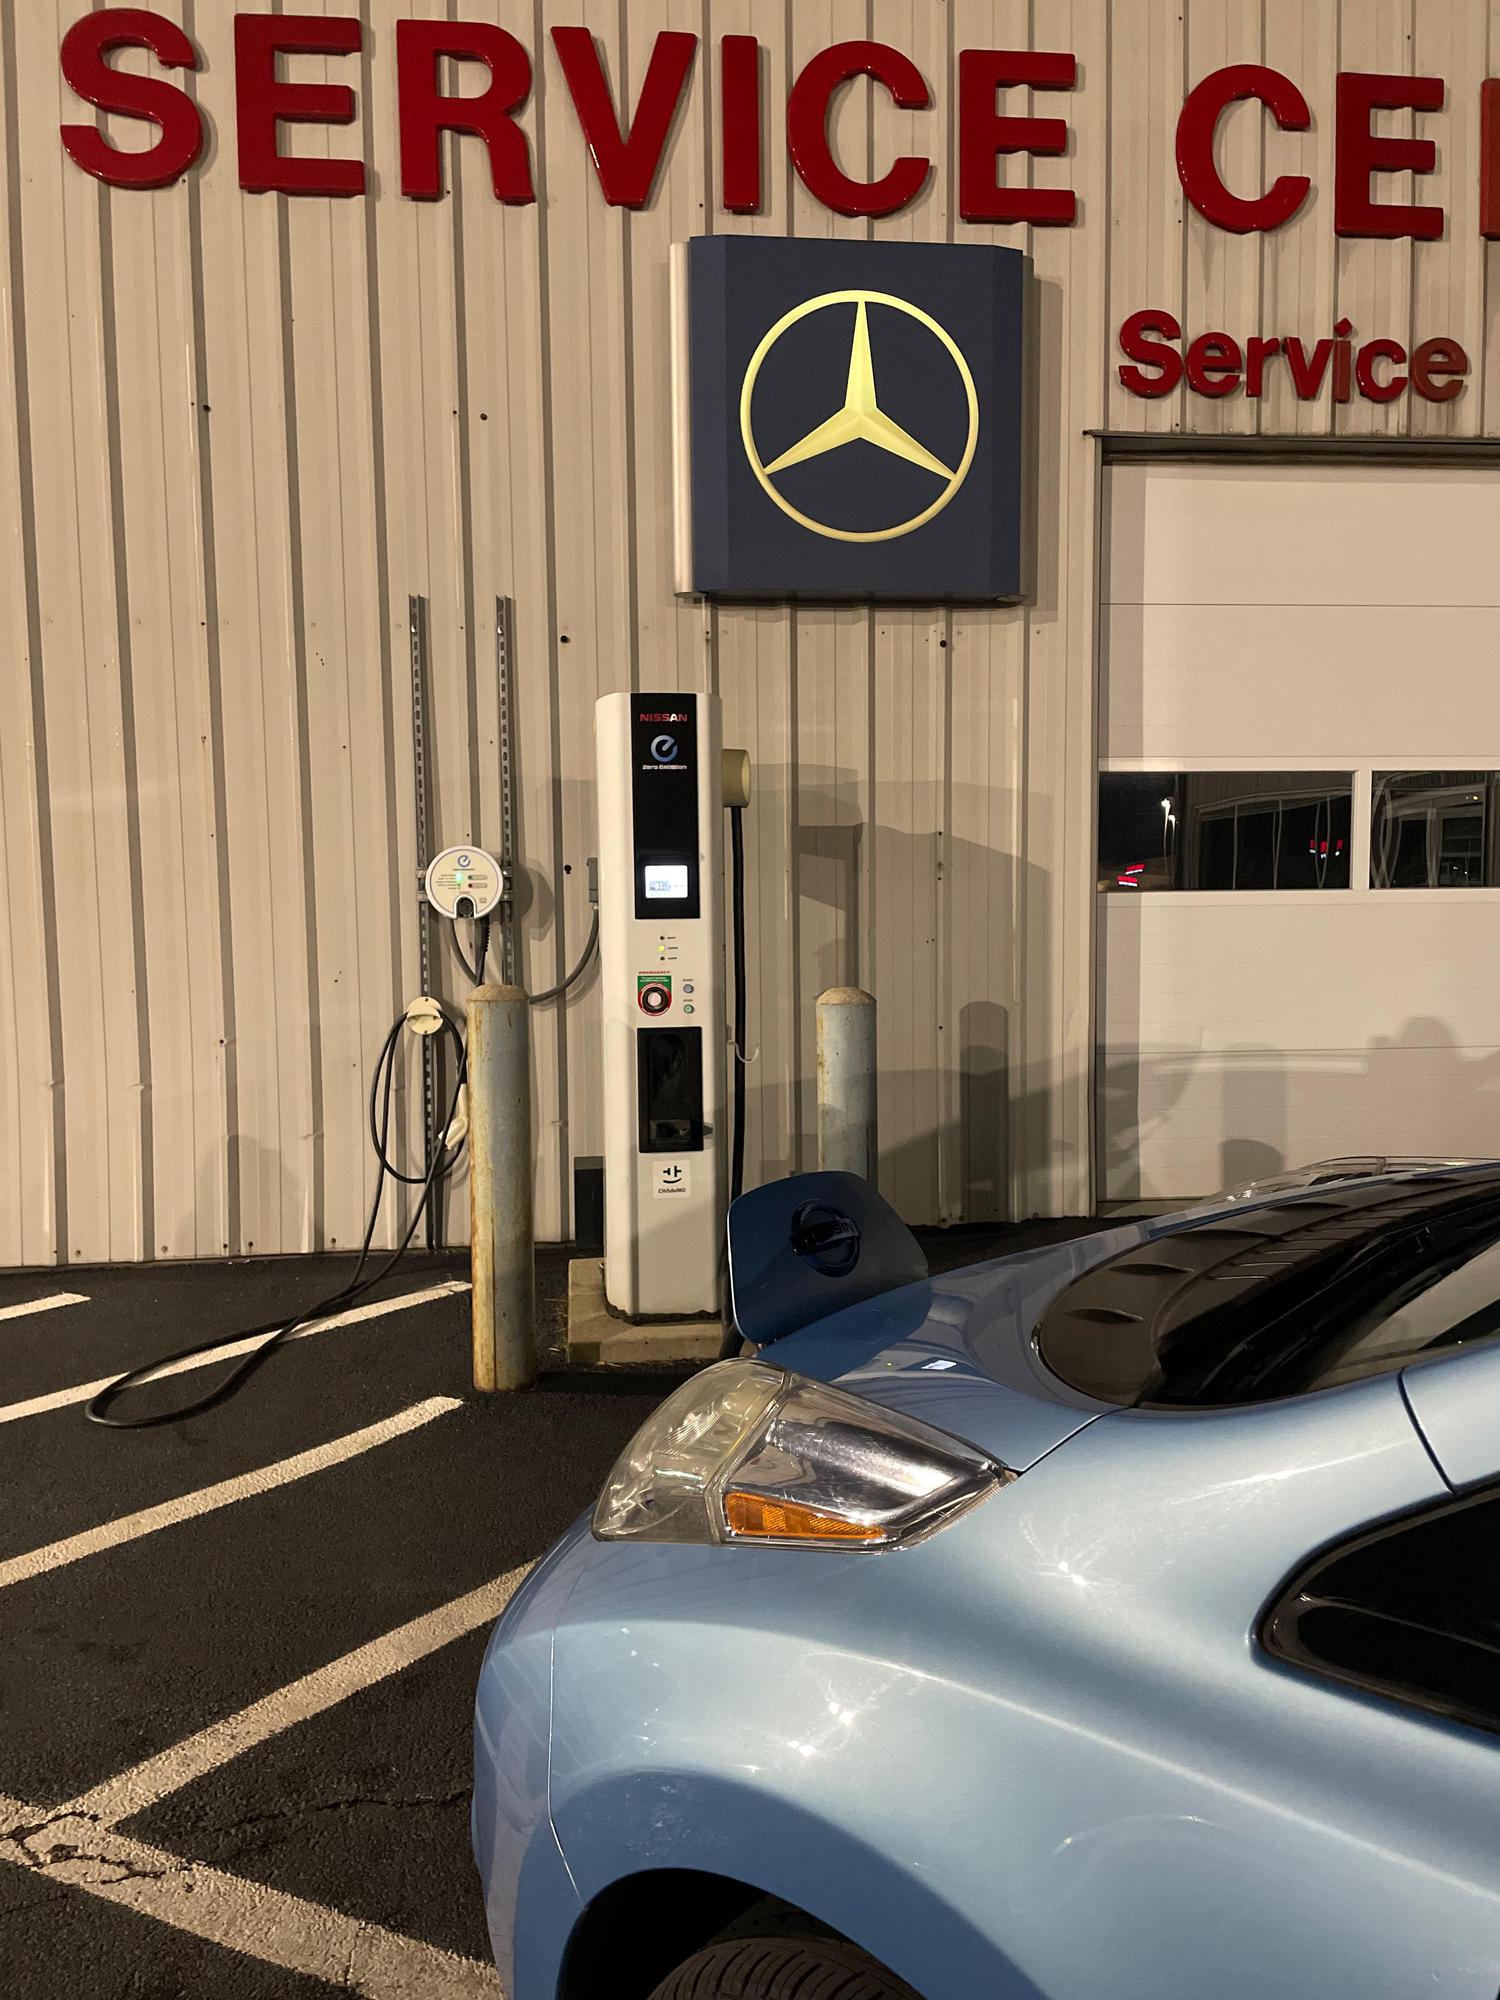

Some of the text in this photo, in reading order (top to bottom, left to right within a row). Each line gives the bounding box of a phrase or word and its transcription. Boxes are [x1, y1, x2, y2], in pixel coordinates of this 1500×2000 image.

[59, 8, 1500, 240] SERVICE CE
[1118, 308, 1468, 402] Service
[640, 713, 687, 721] NISSAN
